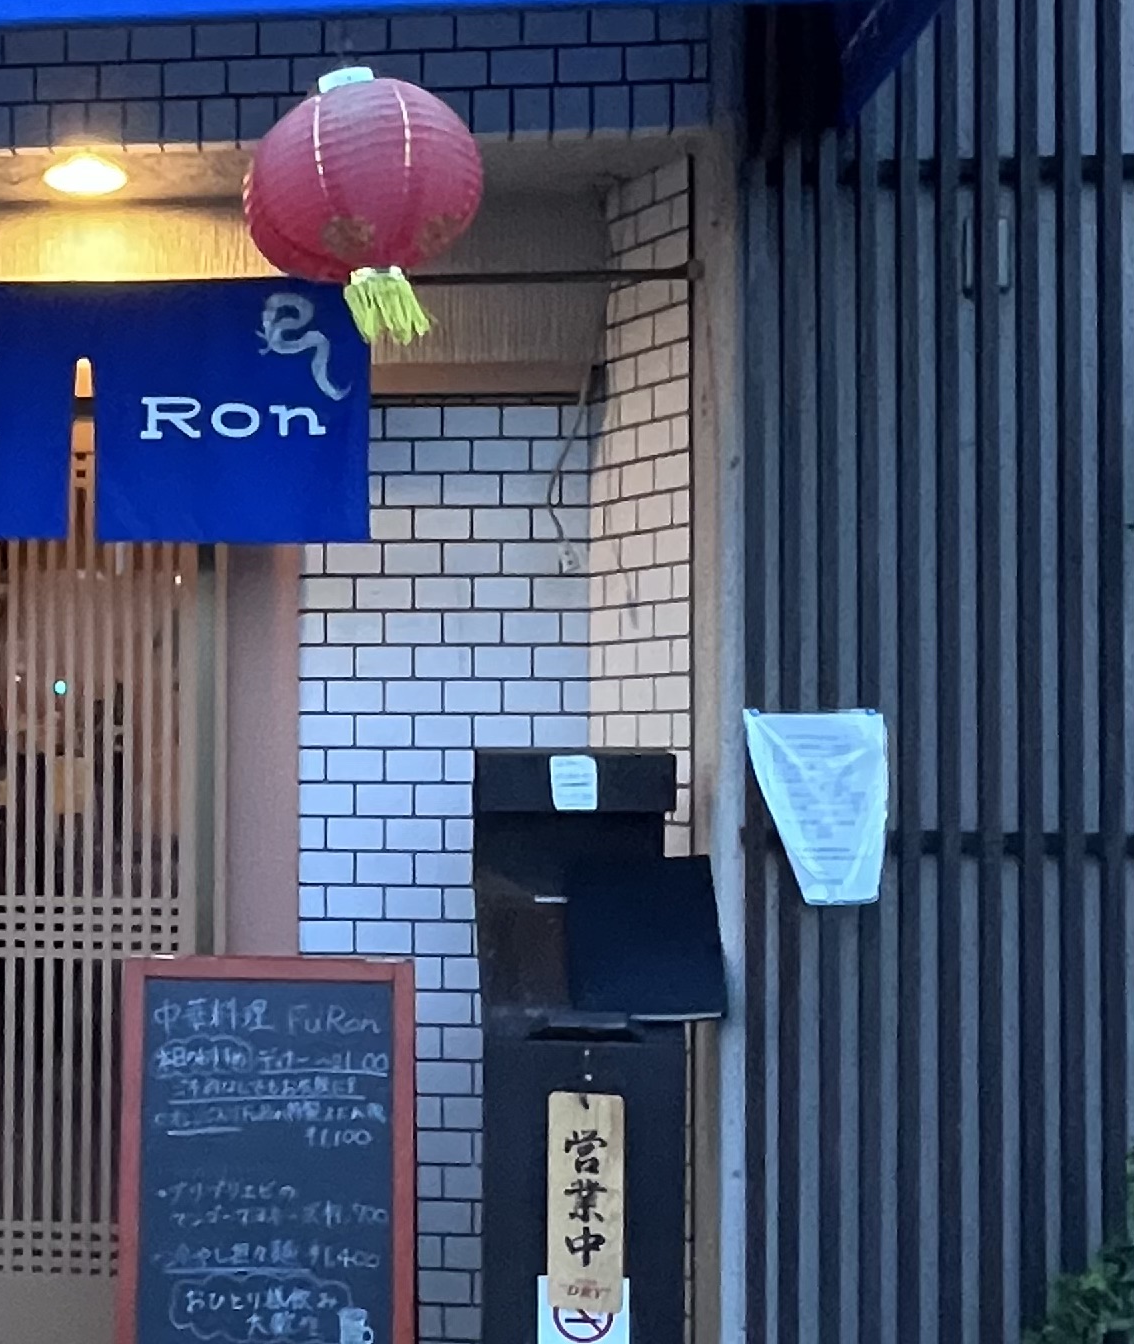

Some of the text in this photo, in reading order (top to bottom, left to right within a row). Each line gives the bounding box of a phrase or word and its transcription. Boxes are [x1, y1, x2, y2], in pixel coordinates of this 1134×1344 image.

[140, 396, 327, 440] Ron
[153, 998, 275, 1034] 中華料理
[564, 1130, 608, 1267] 営業中
